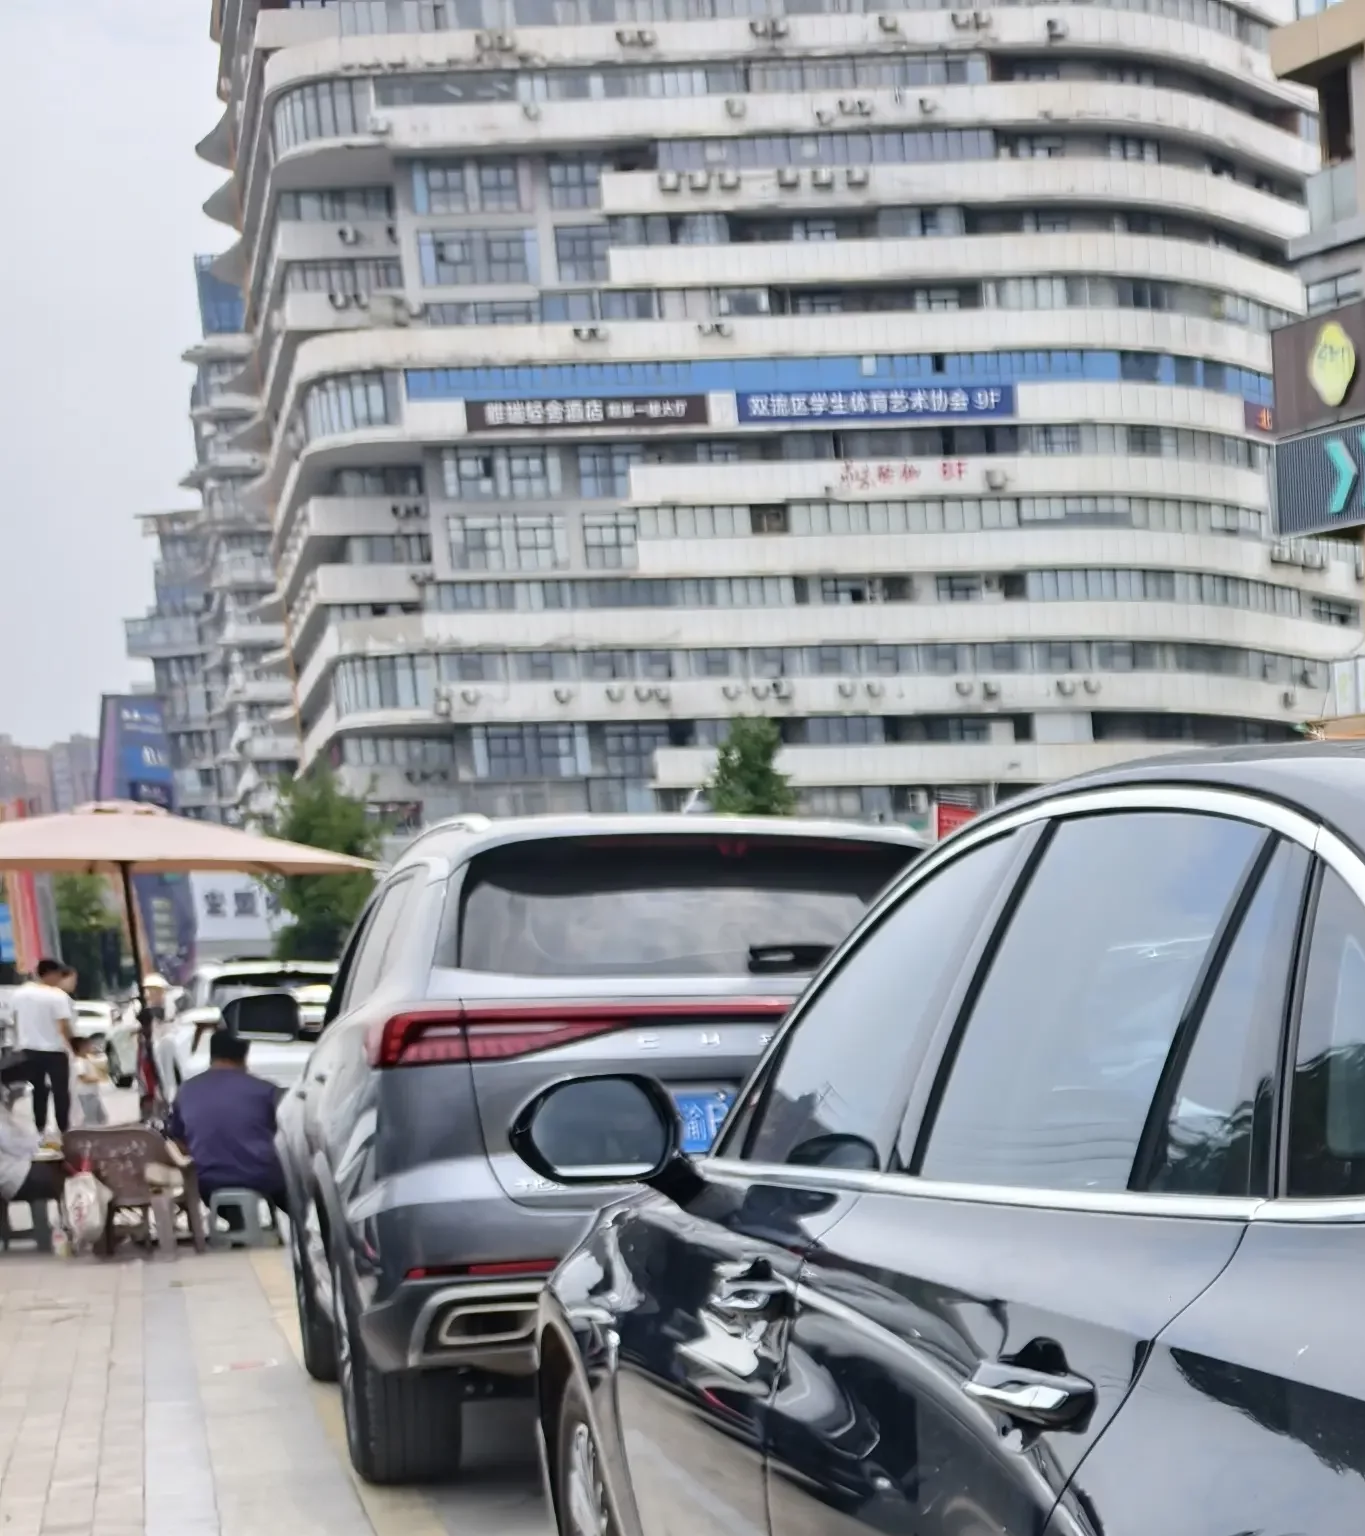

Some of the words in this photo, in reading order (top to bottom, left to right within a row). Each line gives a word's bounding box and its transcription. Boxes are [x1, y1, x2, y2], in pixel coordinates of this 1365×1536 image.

[748, 389, 970, 416] 双流区学生体育艺术协会
